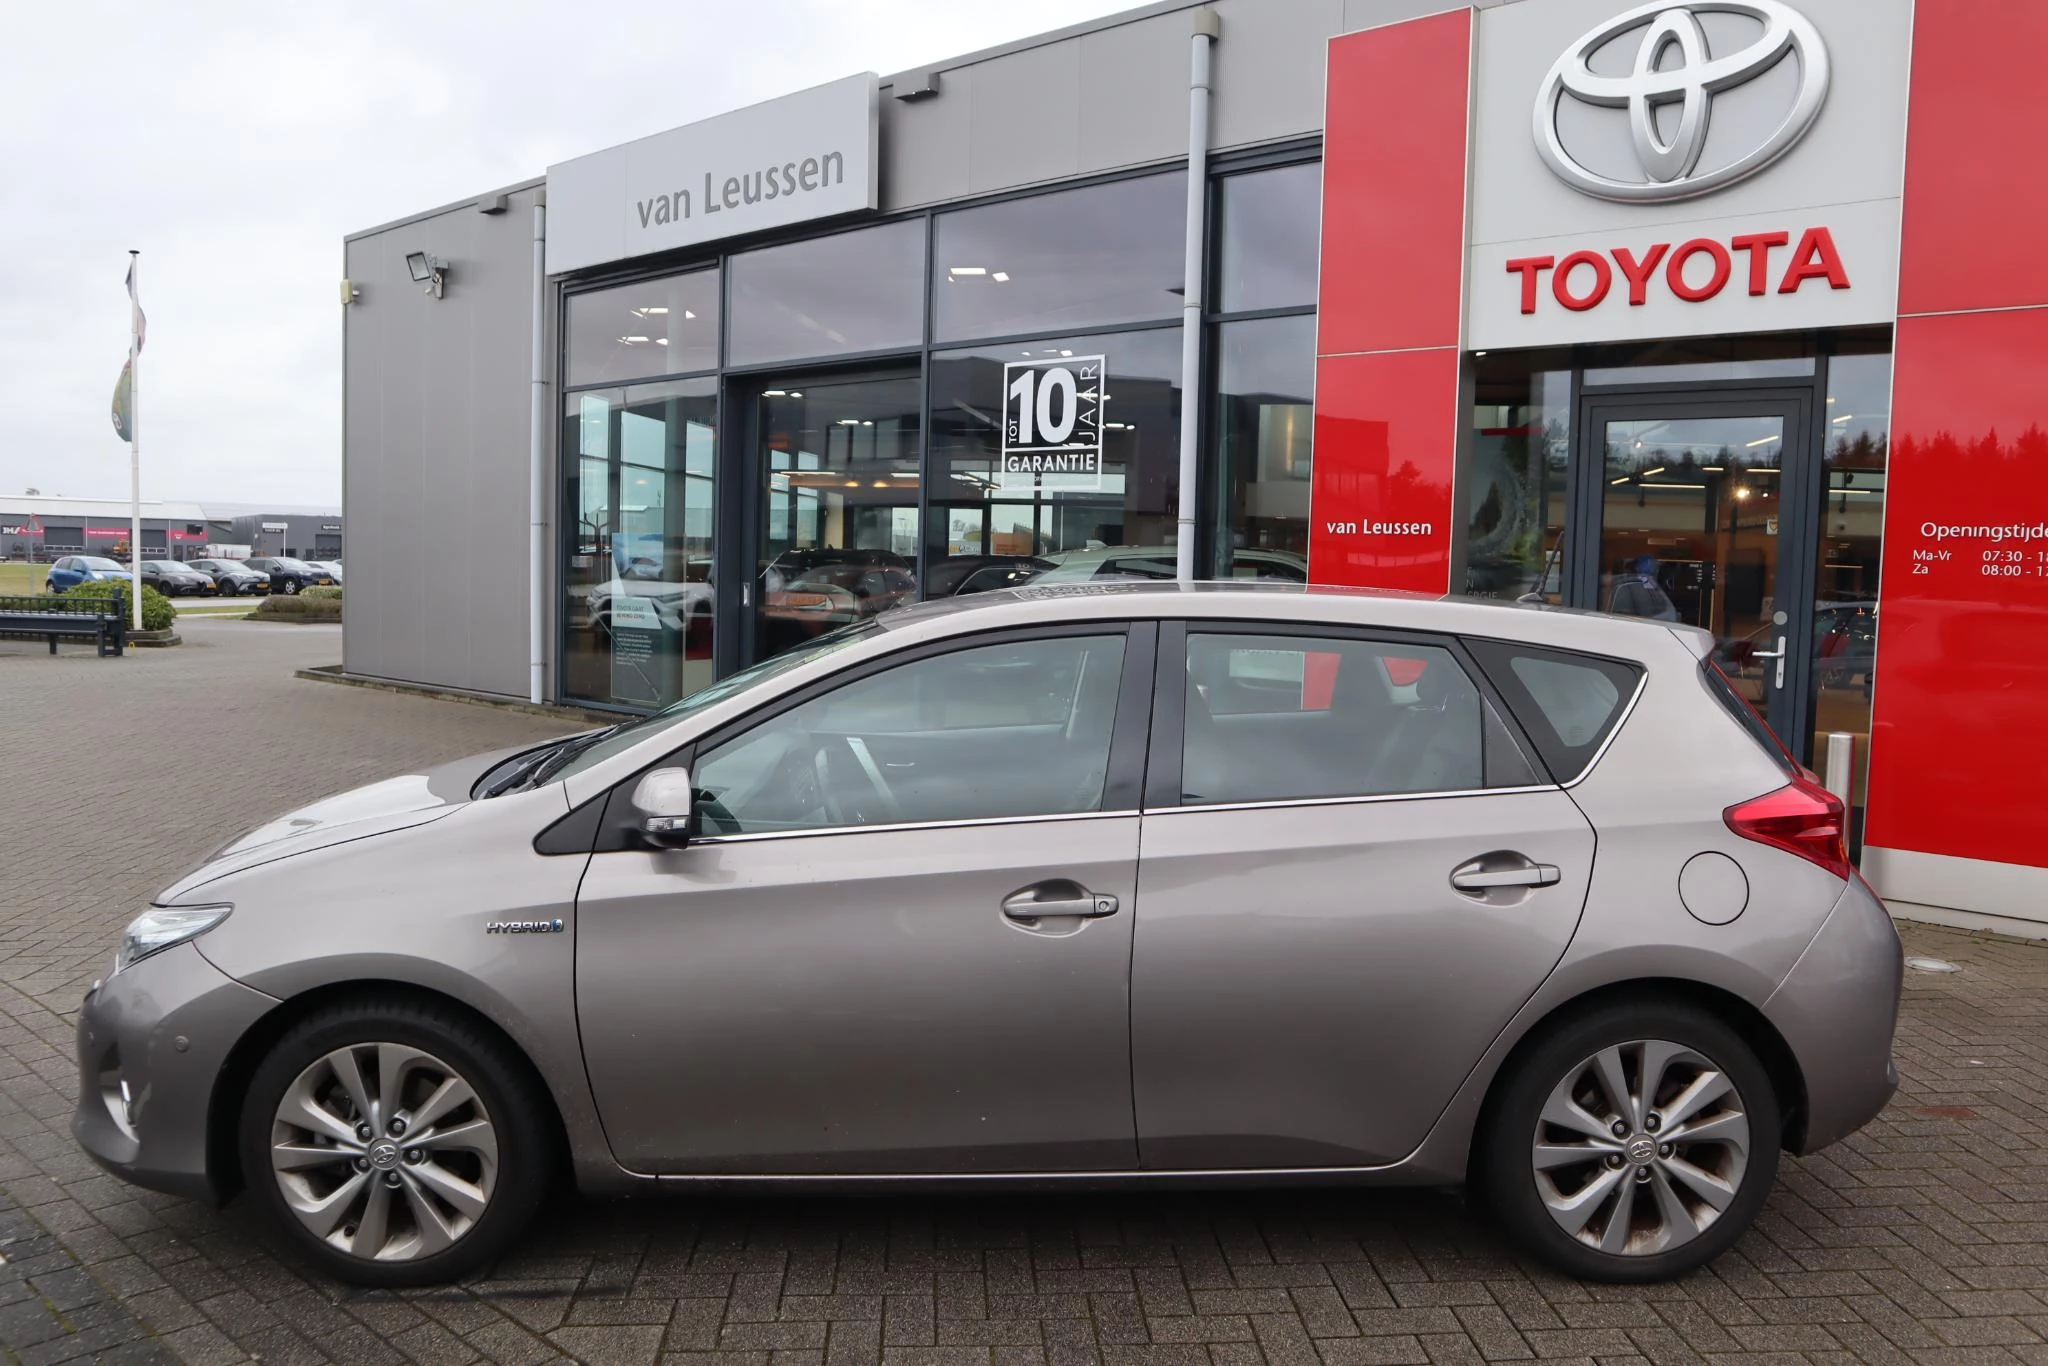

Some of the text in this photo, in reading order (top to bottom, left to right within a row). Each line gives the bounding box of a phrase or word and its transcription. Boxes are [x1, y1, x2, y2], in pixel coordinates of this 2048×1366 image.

[637, 150, 844, 229] van Leussen
[1506, 226, 1851, 315] TOYOTA
[1009, 367, 1077, 444] 10
[1078, 363, 1098, 441] JAAR
[1008, 418, 1018, 444] TOT
[1007, 453, 1095, 473] GARANTIE
[1326, 518, 1432, 535] van Leussen
[1912, 549, 1952, 561] Ma-Vr
[1982, 550, 2023, 562] 07:30
[2037, 551, 2048, 563] 1
[1912, 563, 1929, 575] Za
[1981, 564, 2022, 577] 08:00
[2036, 565, 2048, 577] 1
[486, 920, 552, 934] HYBRID
